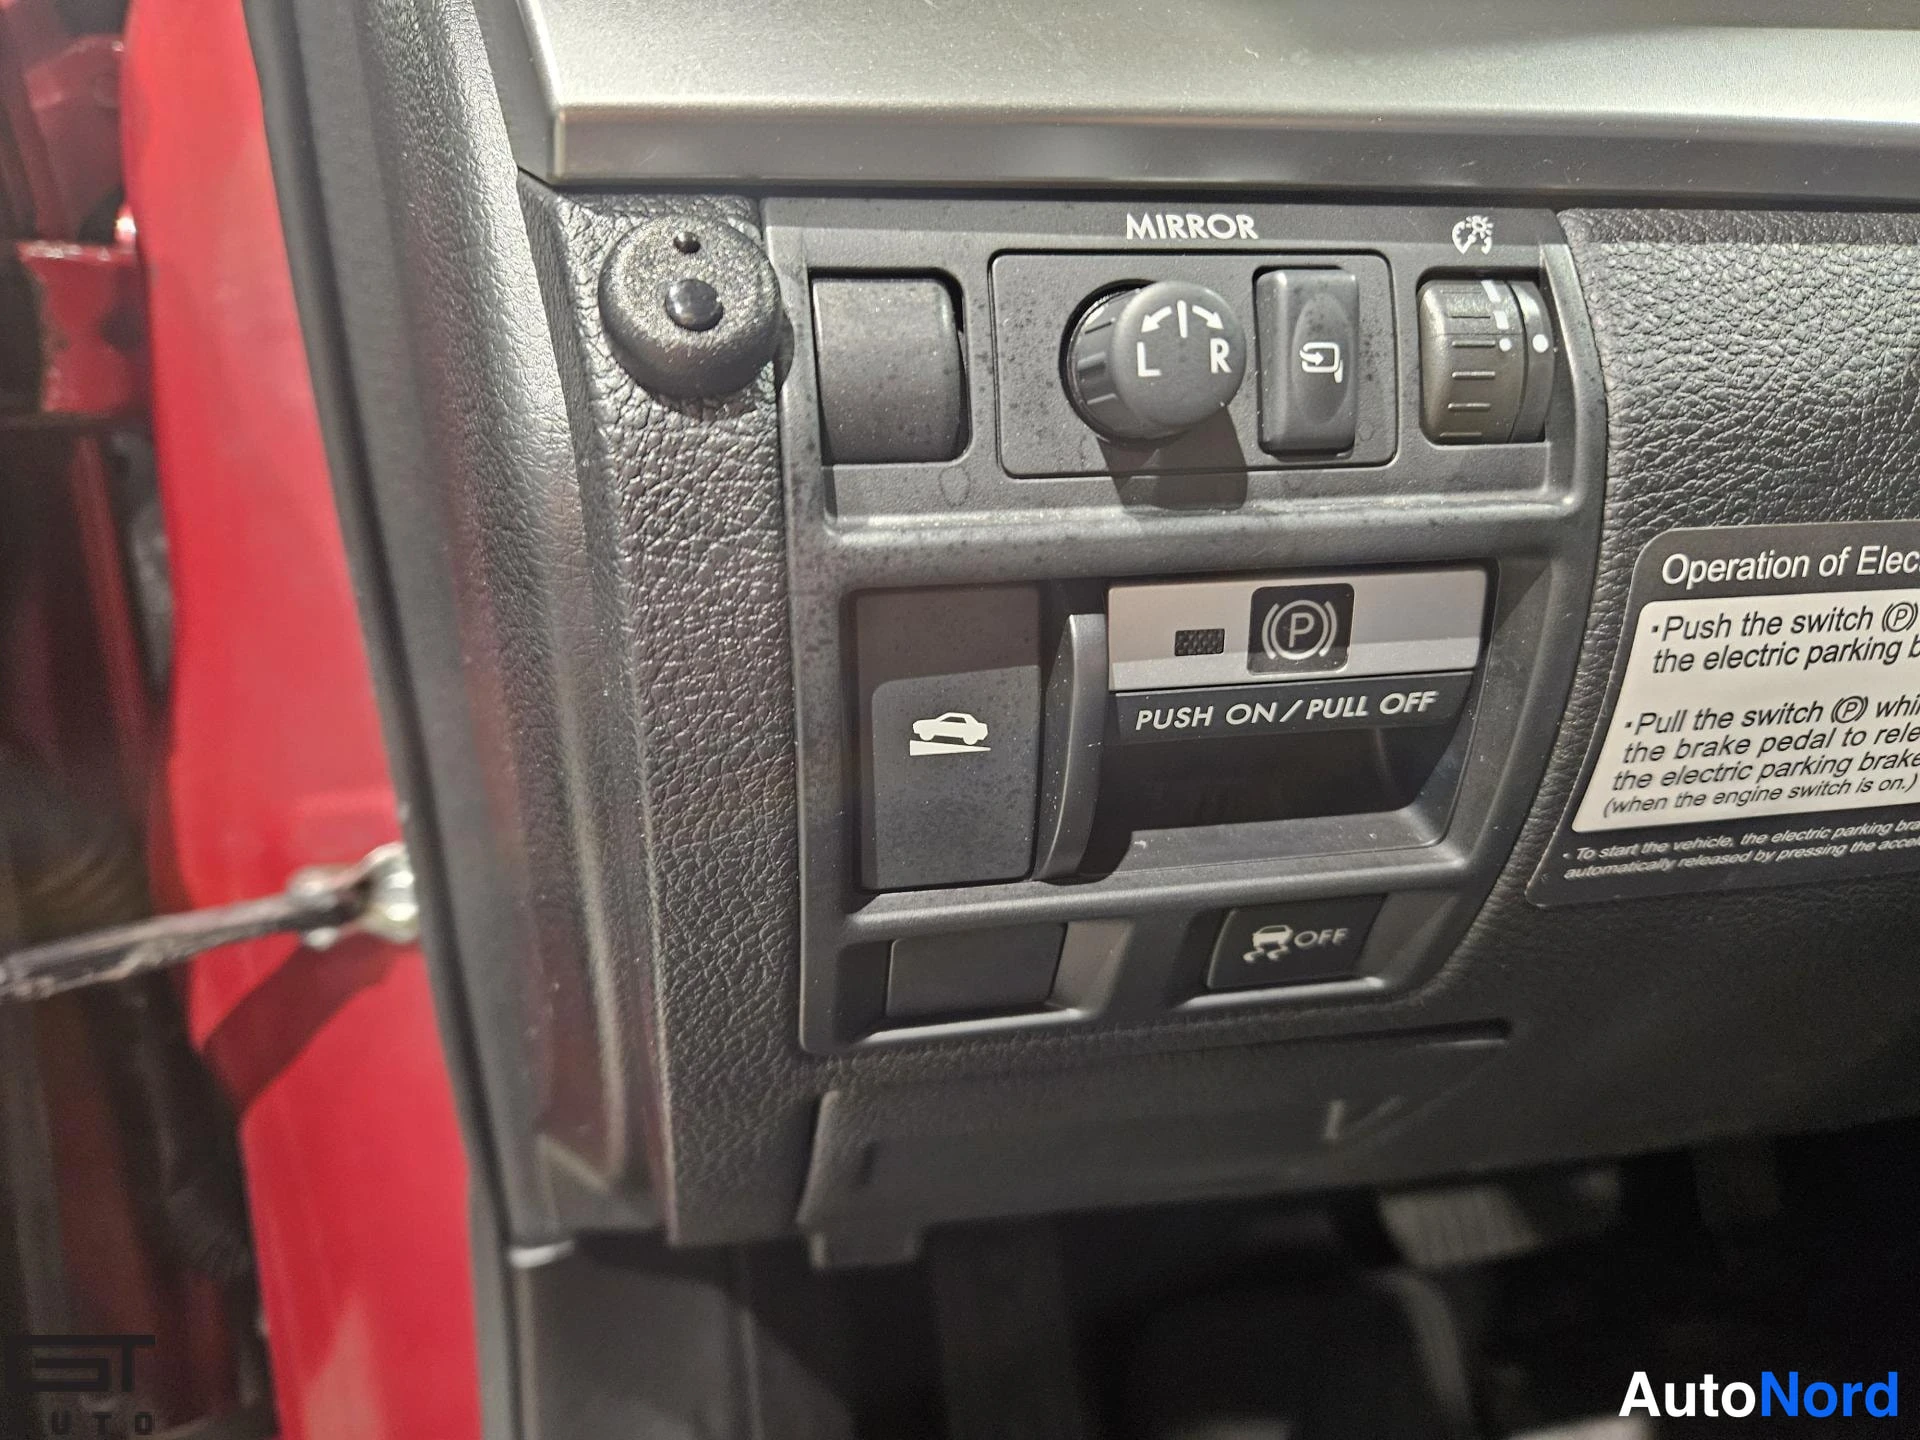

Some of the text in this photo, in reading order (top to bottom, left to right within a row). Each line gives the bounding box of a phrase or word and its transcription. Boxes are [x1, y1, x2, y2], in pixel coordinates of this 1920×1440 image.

[1126, 213, 1259, 241] MIRROR
[1136, 339, 1233, 377] L R
[1662, 549, 1809, 591] Operation
[1818, 545, 1853, 578] of
[1740, 611, 1783, 637] the
[1790, 605, 1874, 634] switch
[1652, 647, 1695, 674] the
[1703, 641, 1800, 671] electric
[1803, 636, 1903, 671] parking
[1135, 705, 1214, 731] PUSH
[1379, 690, 1439, 714] OFF
[1692, 707, 1734, 731] the
[1741, 701, 1824, 728] switch
[1622, 721, 1920, 764] the brake pedal to rele
[1612, 748, 1920, 791] the electric parking brake
[1603, 773, 1918, 819] (when the engine switch is on.)
[1563, 857, 1677, 880] automatically
[1676, 850, 1751, 868] released
[1753, 848, 1777, 864] by
[1775, 843, 1849, 862] pressing
[1849, 841, 1877, 854] the
[1575, 847, 1597, 862] To
[1598, 843, 1639, 859] start
[1640, 840, 1672, 855] the
[1673, 835, 1734, 852] vehicle,
[1740, 832, 1768, 846] the
[1771, 826, 1833, 844] electric
[1831, 821, 1895, 841] parking
[1294, 927, 1349, 949] OFF
